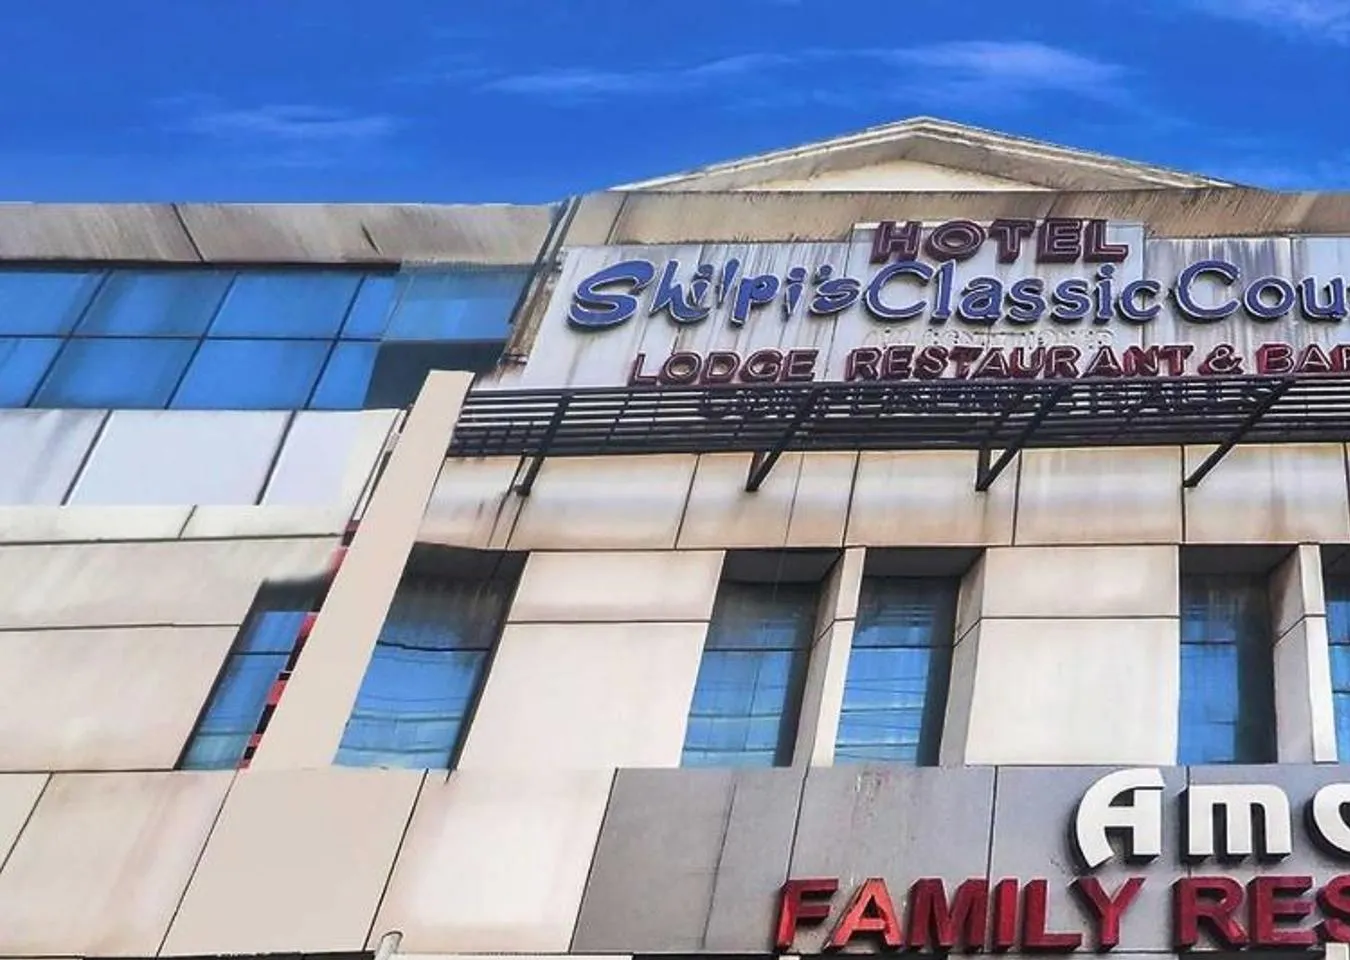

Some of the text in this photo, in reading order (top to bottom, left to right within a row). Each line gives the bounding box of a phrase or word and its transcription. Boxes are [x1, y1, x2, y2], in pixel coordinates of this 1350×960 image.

[870, 218, 1129, 263] HOTEL
[567, 258, 862, 328] Shilpi's
[865, 258, 1163, 324] Classic
[627, 349, 820, 386] LODGE
[844, 344, 1194, 382] RESTAURANT
[1200, 343, 1244, 376] &
[774, 875, 1146, 952] FAMILY
